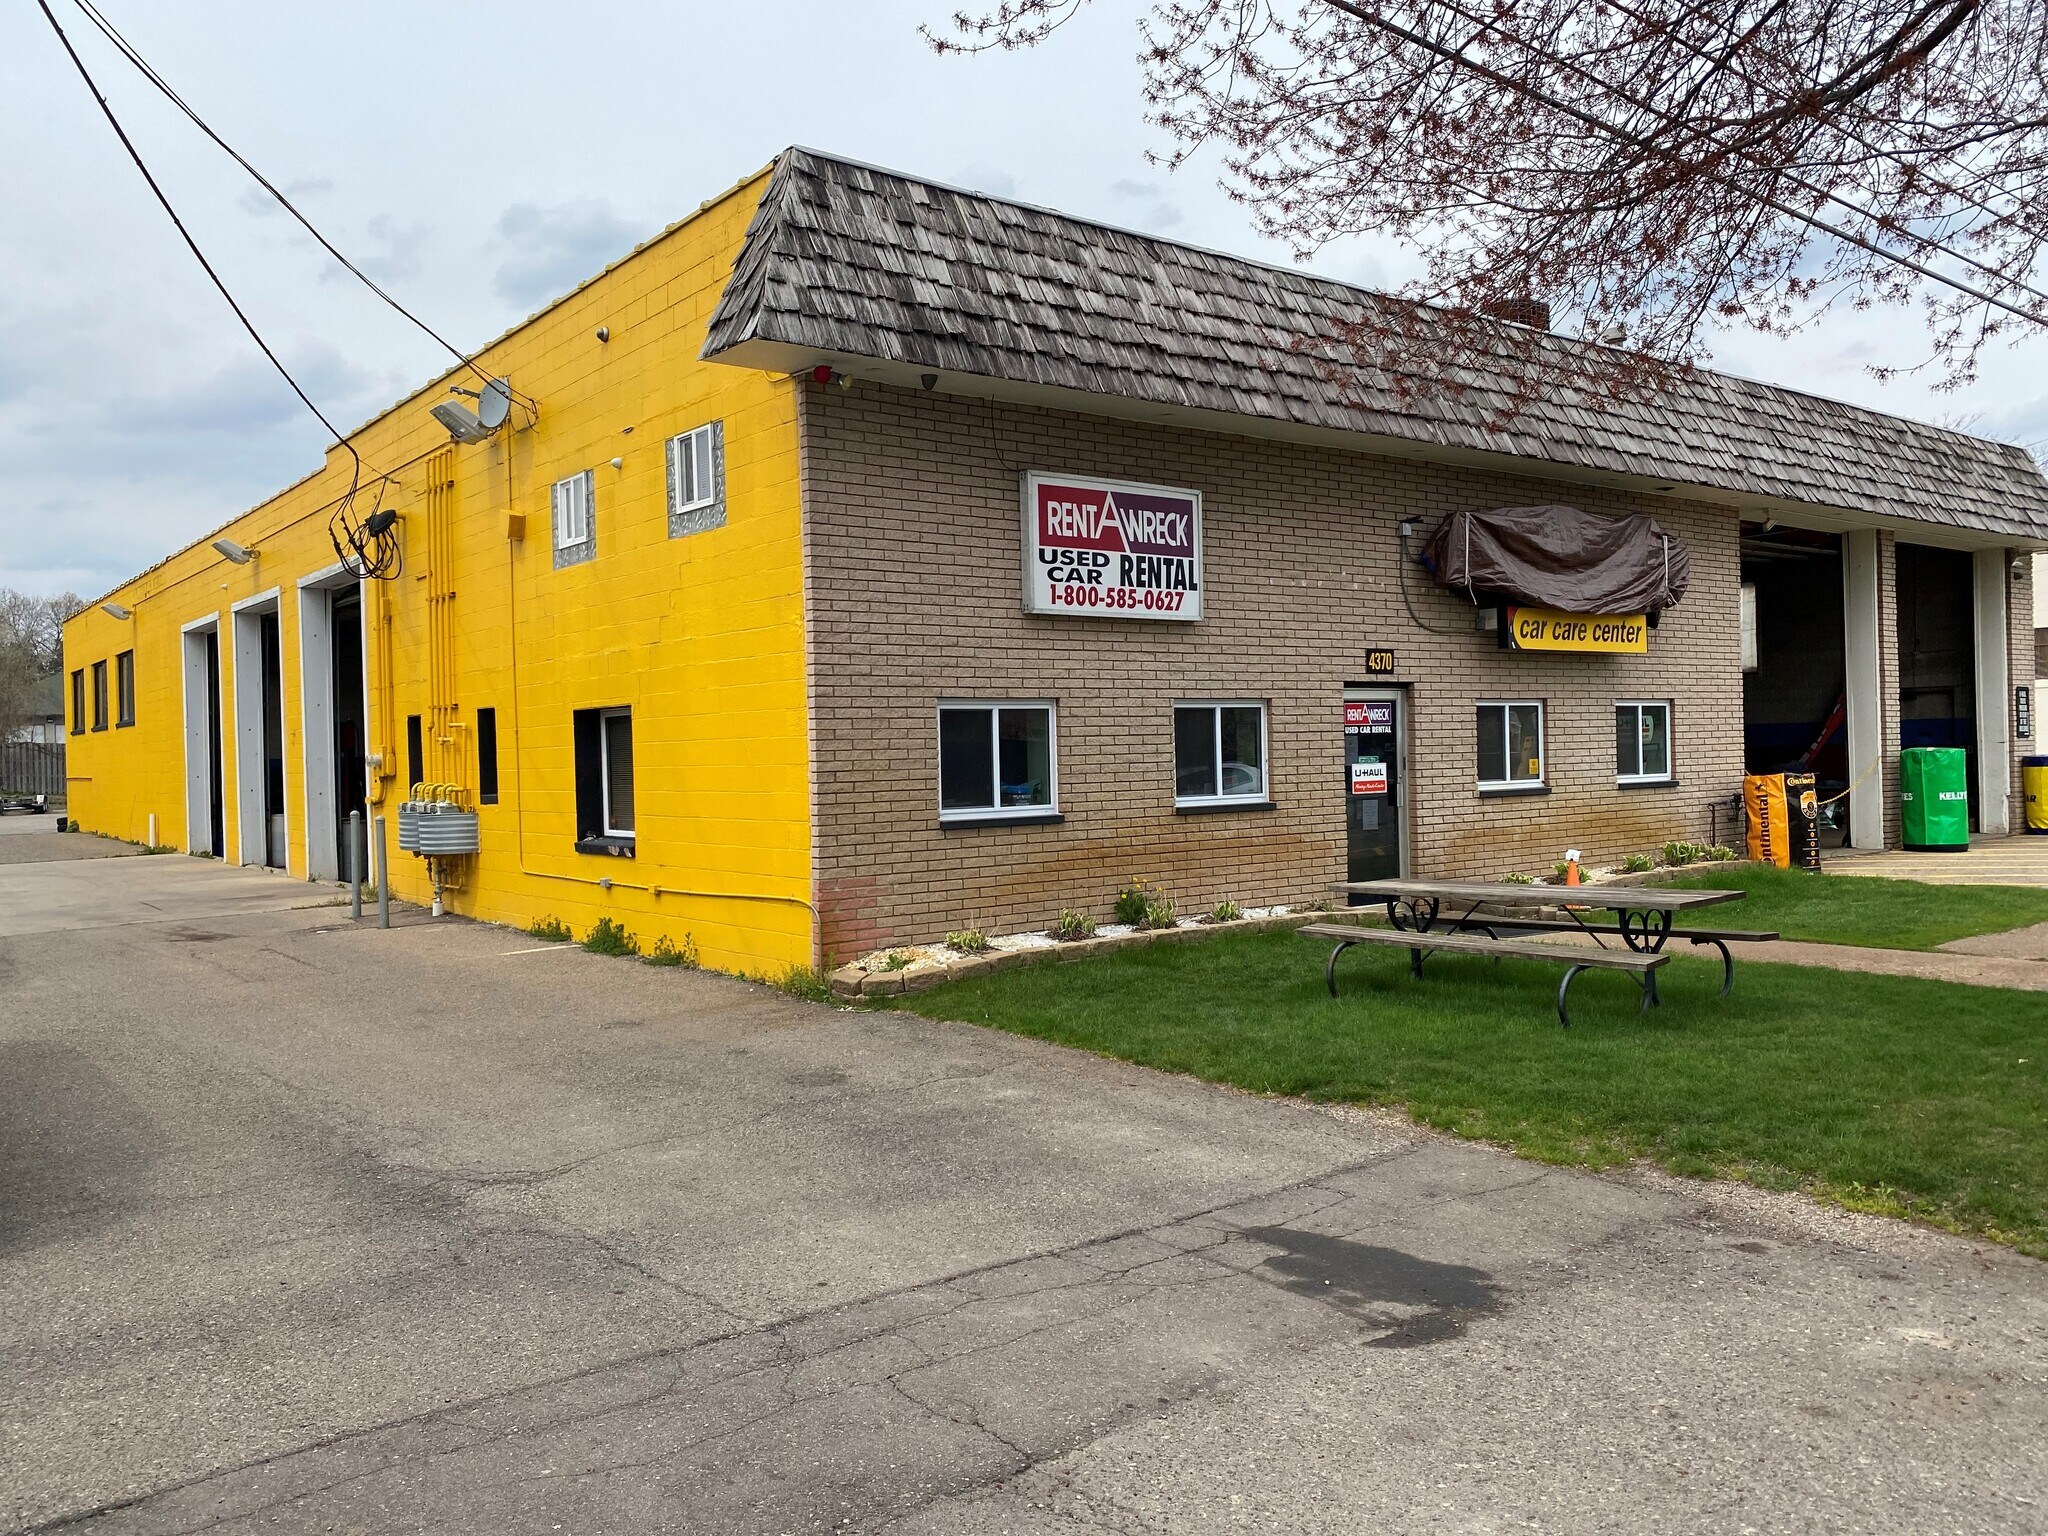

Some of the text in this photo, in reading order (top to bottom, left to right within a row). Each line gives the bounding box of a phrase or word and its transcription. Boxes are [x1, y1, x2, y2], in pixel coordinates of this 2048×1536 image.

[1047, 491, 1189, 553] RENT A WRECK
[1039, 548, 1198, 591] USED RENTAL
[1047, 566, 1103, 585] CAR
[1050, 584, 1185, 611] 1-800-585-0627
[1519, 619, 1642, 643] car care center
[1369, 652, 1392, 670] 4370
[1347, 708, 1363, 721] RENT
[1367, 708, 1390, 721] WRECK
[1345, 725, 1392, 734] USED CAR RENTAL
[1354, 768, 1384, 777] U-HAUL
